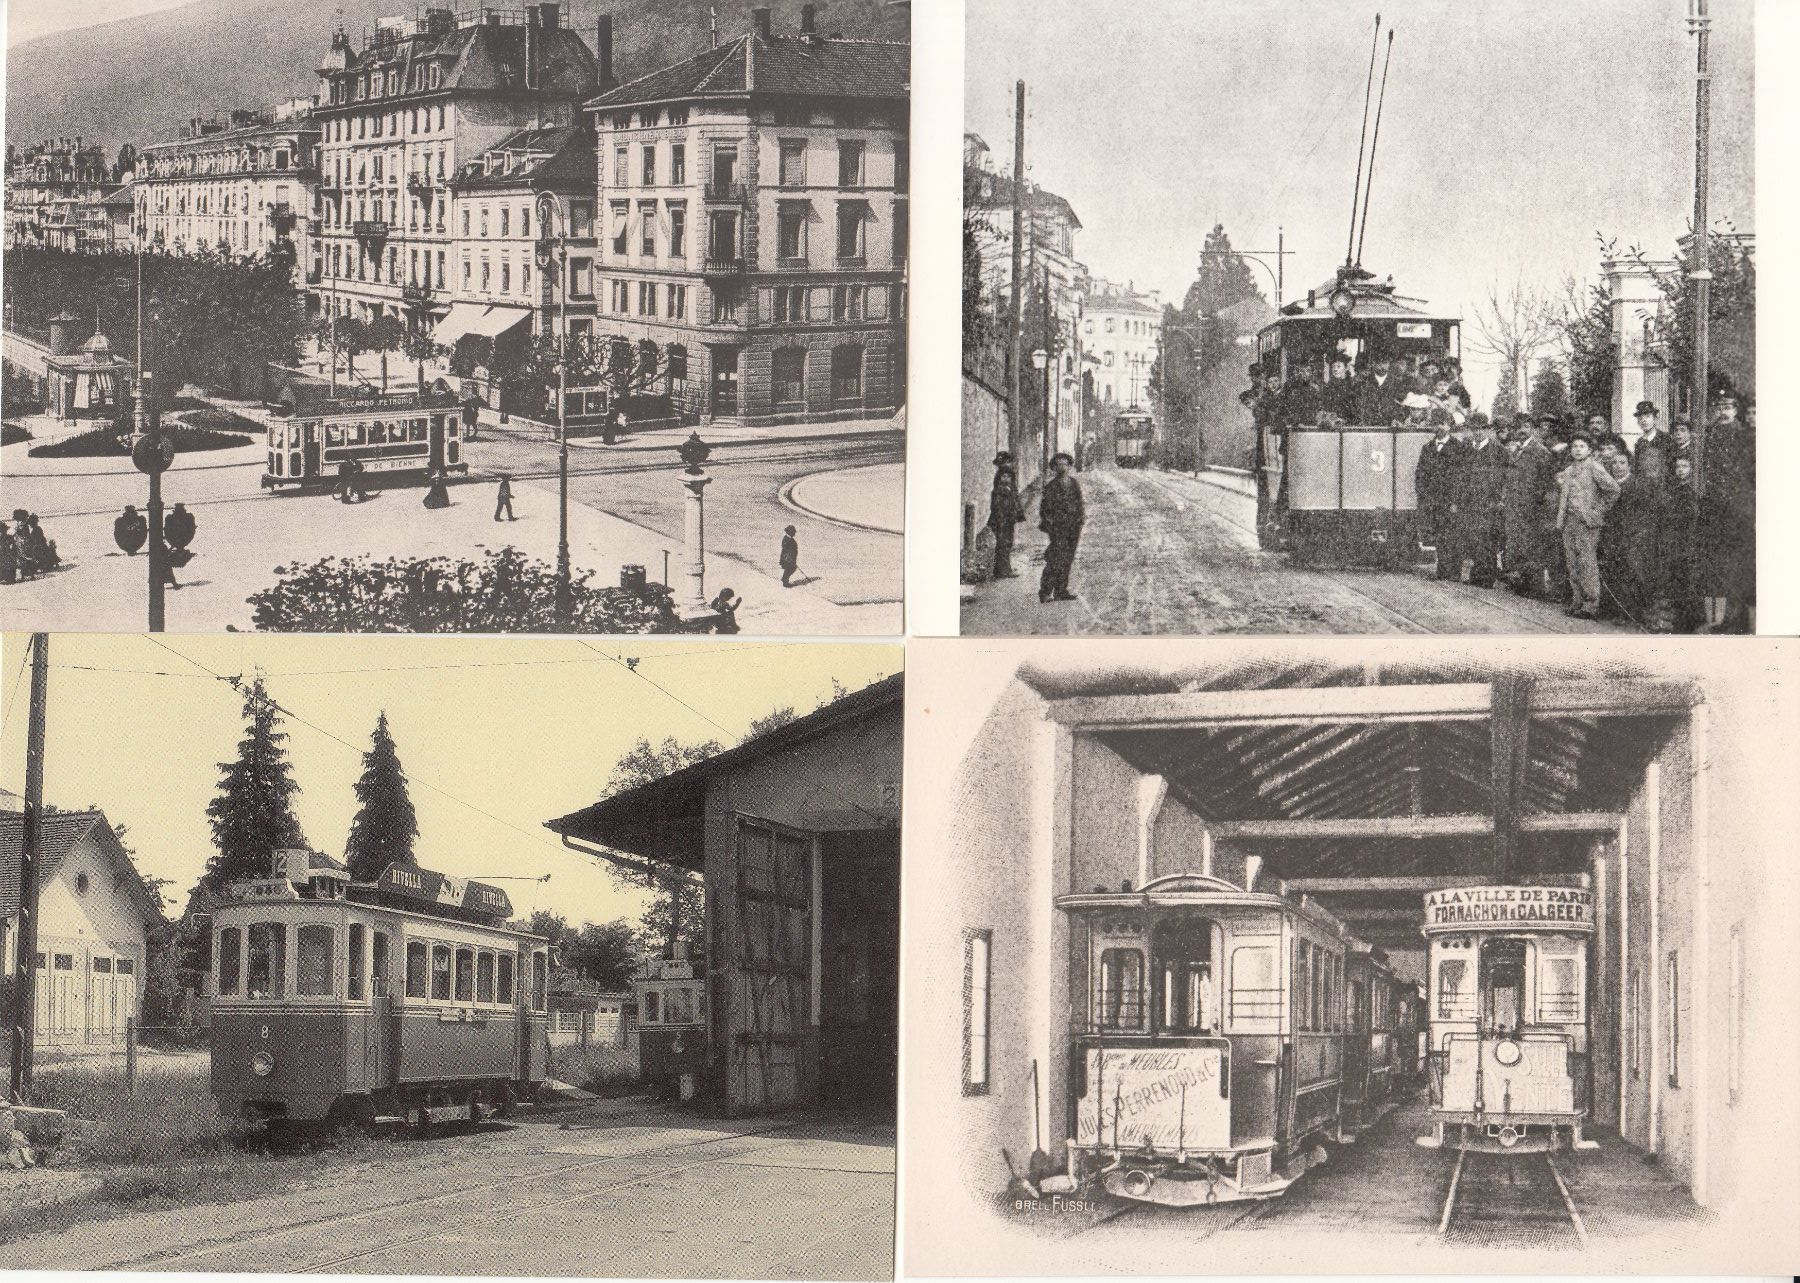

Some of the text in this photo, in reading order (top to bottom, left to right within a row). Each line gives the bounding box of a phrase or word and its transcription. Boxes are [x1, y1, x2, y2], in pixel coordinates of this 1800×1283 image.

[339, 400, 375, 408] RICCARDO
[390, 460, 417, 468] BIENNE
[1371, 450, 1385, 471] 3
[391, 868, 421, 889] RIVELLA
[482, 890, 506, 908] RIVELLA
[1428, 889, 1592, 907] A LA VILLE DE PARIS
[1435, 903, 1508, 923] FORNACHON
[261, 1025, 269, 1039] 8
[1127, 1052, 1187, 1071] MEUBLES
[1113, 1066, 1197, 1121] PERRENOUD
